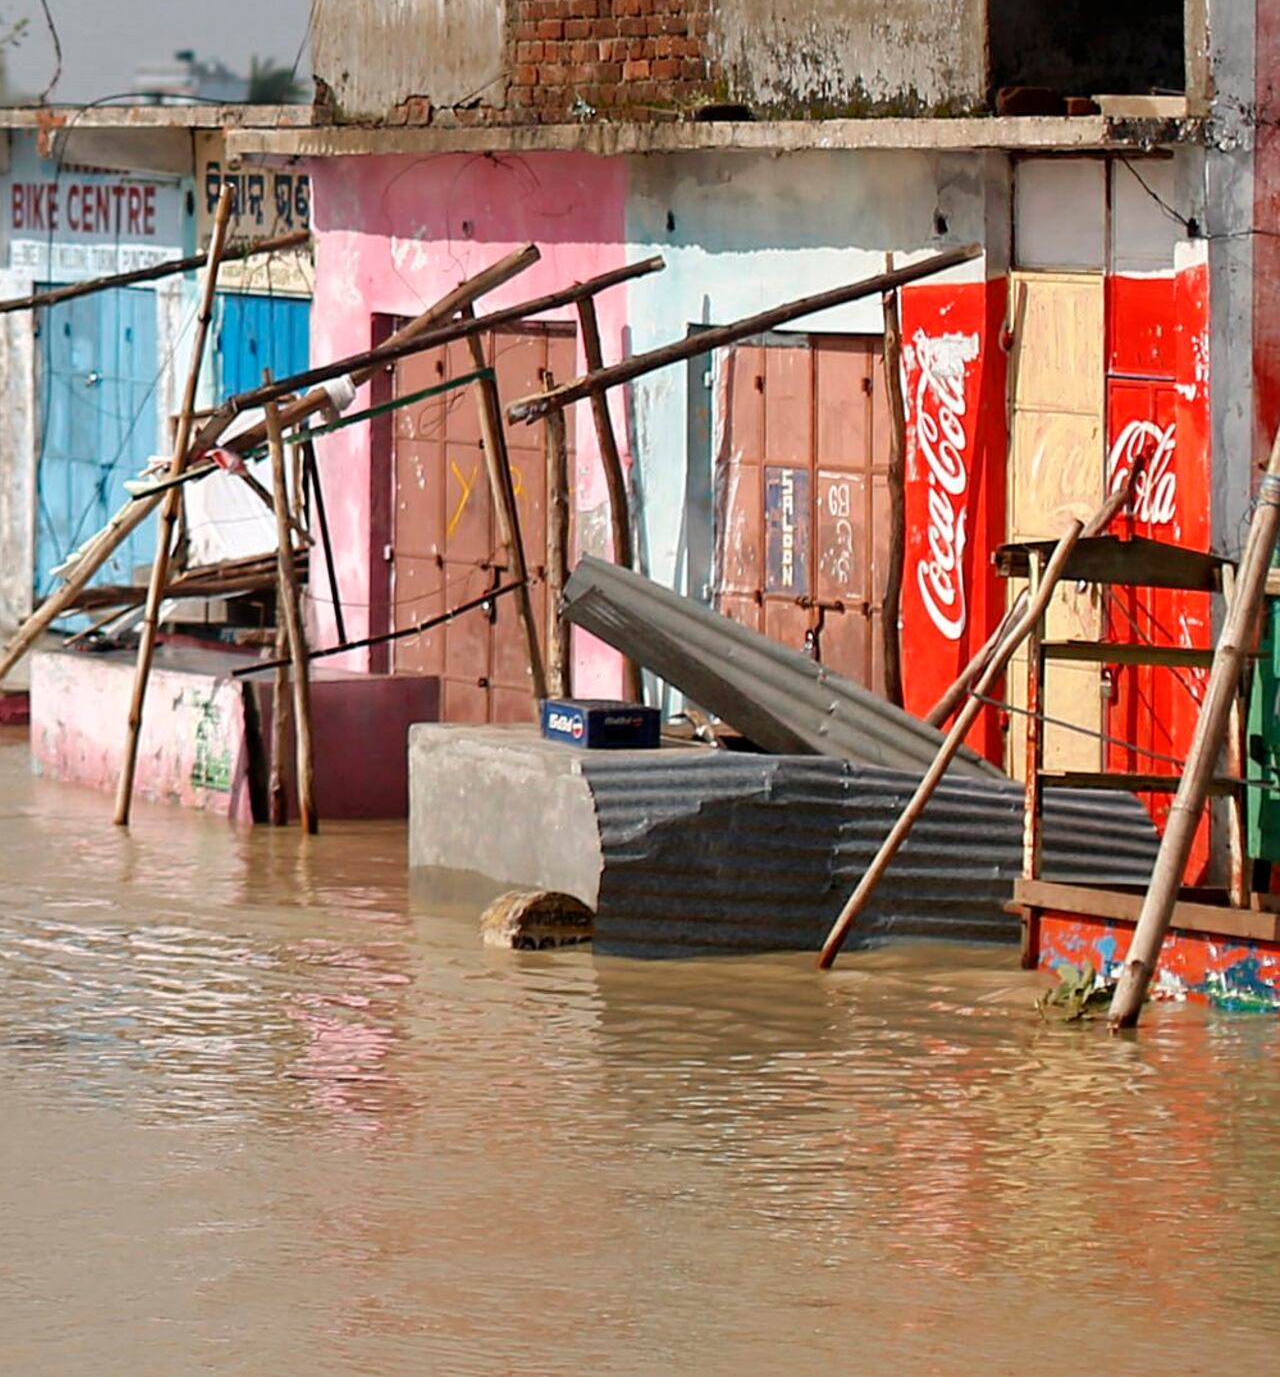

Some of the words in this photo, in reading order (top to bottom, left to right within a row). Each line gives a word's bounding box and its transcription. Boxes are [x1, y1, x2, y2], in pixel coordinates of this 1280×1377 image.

[12, 183, 58, 231] BIKE
[68, 183, 156, 235] CENTRE
[782, 469, 794, 588] SALOON
